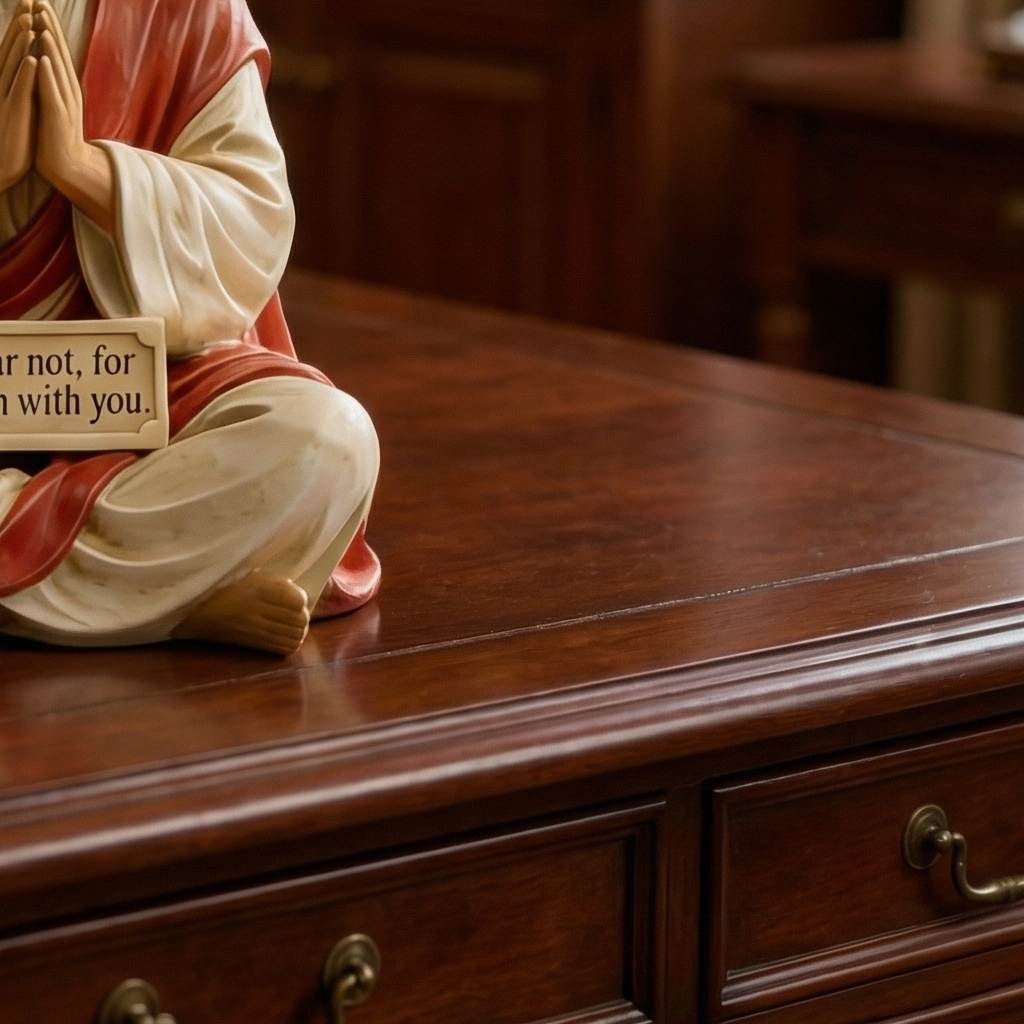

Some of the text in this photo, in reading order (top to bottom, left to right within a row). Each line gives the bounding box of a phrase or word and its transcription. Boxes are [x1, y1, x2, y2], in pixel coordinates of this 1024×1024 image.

[27, 349, 83, 381] not,
[92, 344, 137, 376] for
[17, 384, 81, 416] with
[89, 392, 151, 426] you.
